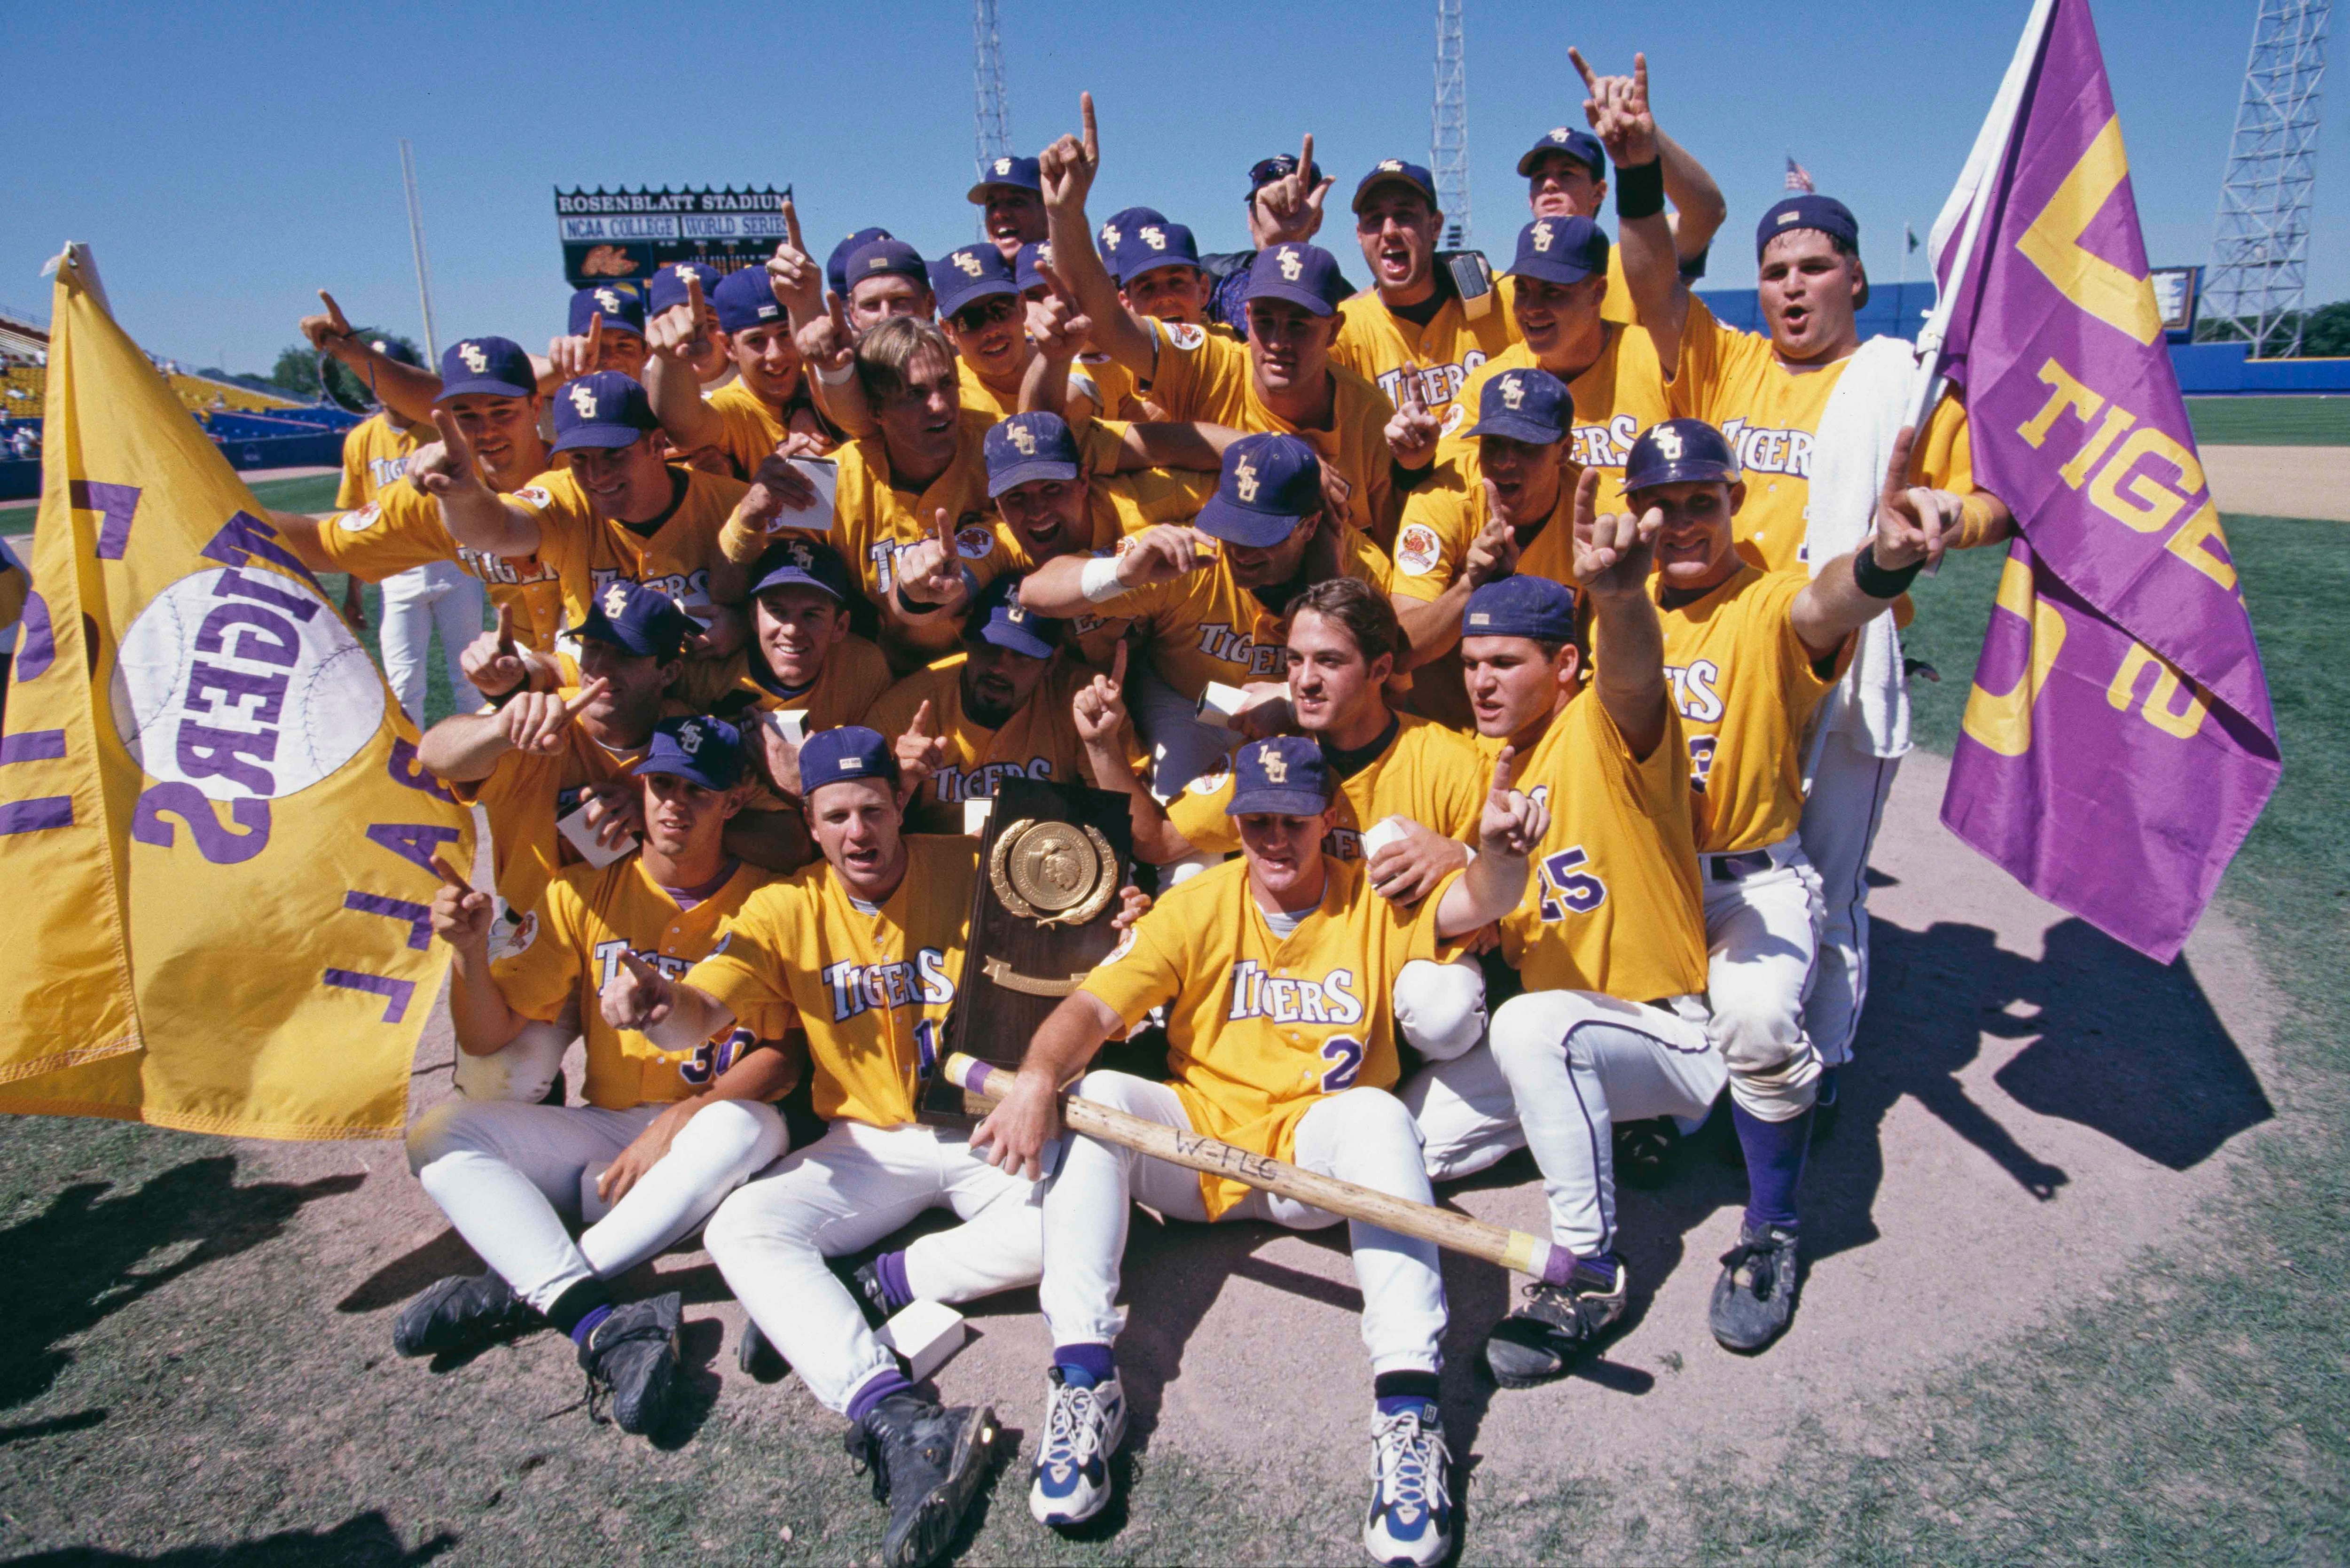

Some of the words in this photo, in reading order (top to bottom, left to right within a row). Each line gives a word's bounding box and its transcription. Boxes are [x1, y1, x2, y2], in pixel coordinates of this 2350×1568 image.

[559, 195, 695, 212] ROSENBLATT
[702, 194, 790, 211] STADIUM
[567, 218, 604, 237] NCAA
[612, 217, 674, 236] COLLEGE
[686, 216, 735, 235] WORLD
[743, 216, 787, 234] SERIES
[1140, 226, 1166, 250] LSU
[1531, 219, 1554, 253] LSU
[951, 251, 983, 277] LSU
[1276, 246, 1303, 281] LSU
[594, 288, 620, 314] LSU
[458, 343, 488, 373] LSU
[569, 383, 597, 419] LSU
[1498, 374, 1526, 410] LSU
[1006, 421, 1034, 456] LSU
[1650, 424, 1683, 460] LSU
[1235, 454, 1260, 502] LSU
[2016, 357, 2240, 591] TIGE
[787, 540, 814, 570] LSU
[603, 584, 627, 619] LSU
[677, 719, 704, 753] LSU
[1257, 745, 1288, 783] LSU
[822, 946, 956, 1024] TIGERS
